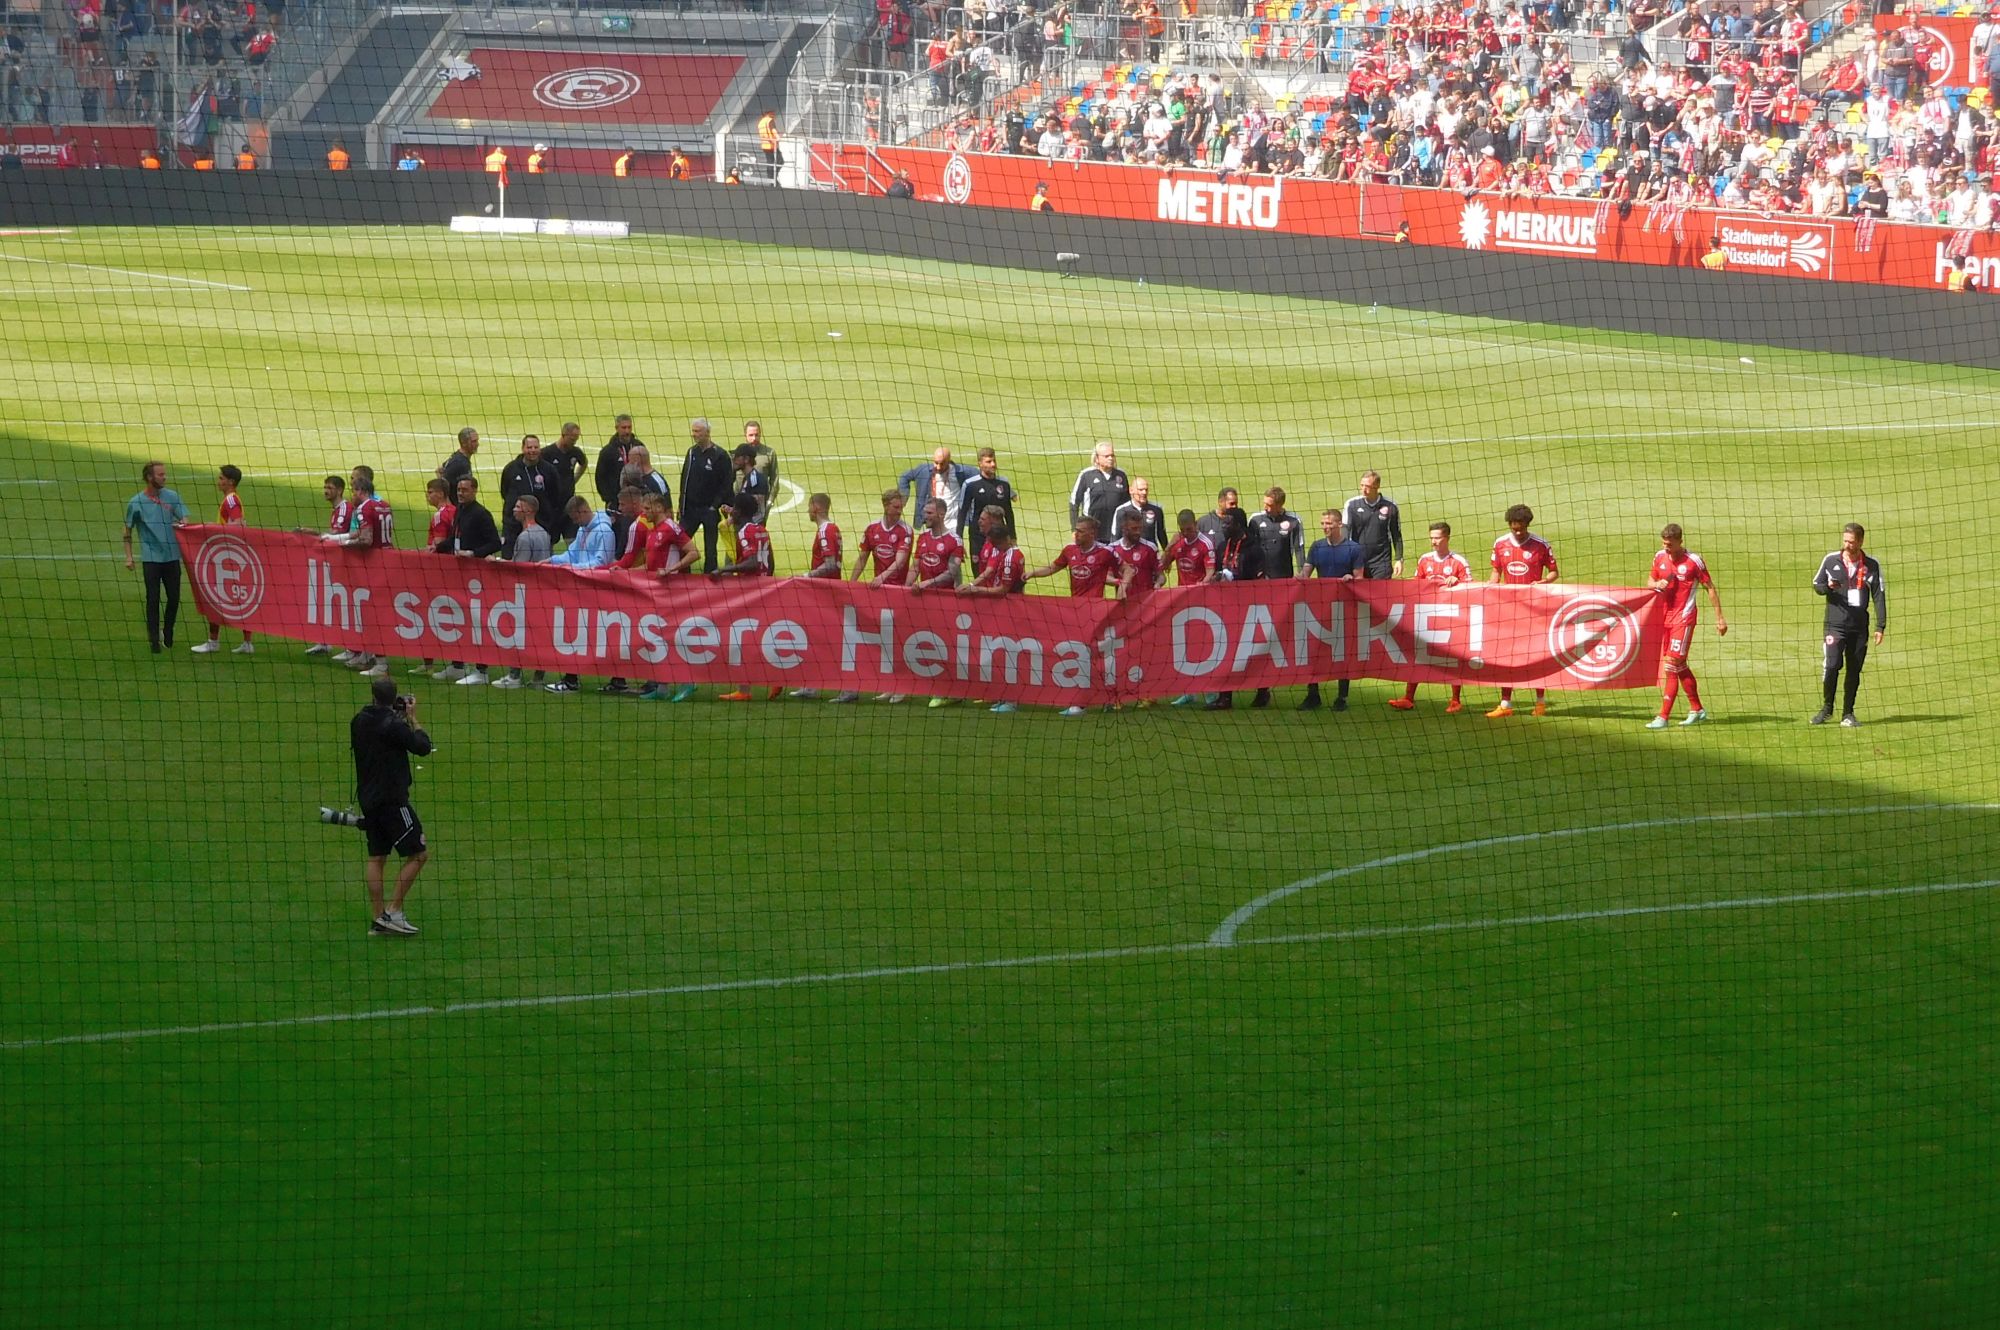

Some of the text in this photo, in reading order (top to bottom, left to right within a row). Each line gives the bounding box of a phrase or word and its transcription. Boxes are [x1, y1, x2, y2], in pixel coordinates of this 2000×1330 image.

[1157, 178, 1279, 228] METRO
[1495, 210, 1597, 245] MERKUR
[1720, 226, 1788, 247] Stadtwerke
[1720, 246, 1788, 267] Düsseldorf
[379, 514, 393, 544] 10
[306, 558, 1485, 689] Ihr seid unsere Heimat. DANKE!
[1670, 639, 1681, 652] 15
